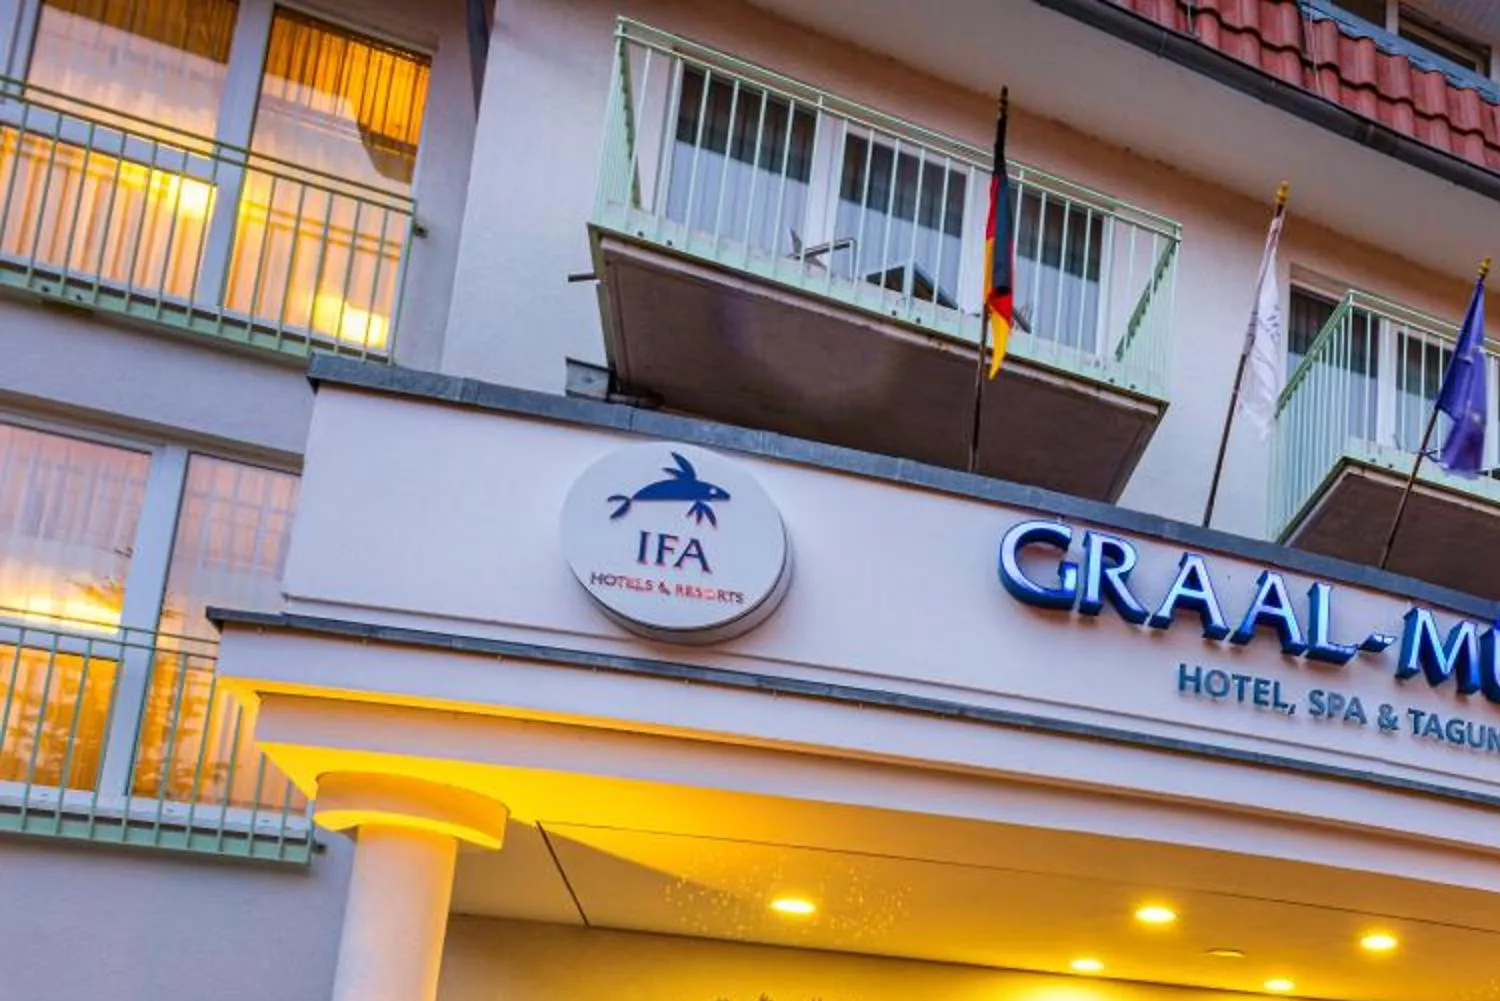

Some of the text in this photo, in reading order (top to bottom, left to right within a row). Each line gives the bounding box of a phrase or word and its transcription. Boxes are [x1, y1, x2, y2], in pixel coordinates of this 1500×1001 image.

[637, 530, 713, 575] IFA
[590, 571, 653, 592] HOTELS
[657, 580, 671, 596] &
[1178, 663, 1297, 716] HOTEL,
[1308, 689, 1368, 725] SPA
[1377, 703, 1399, 731] &
